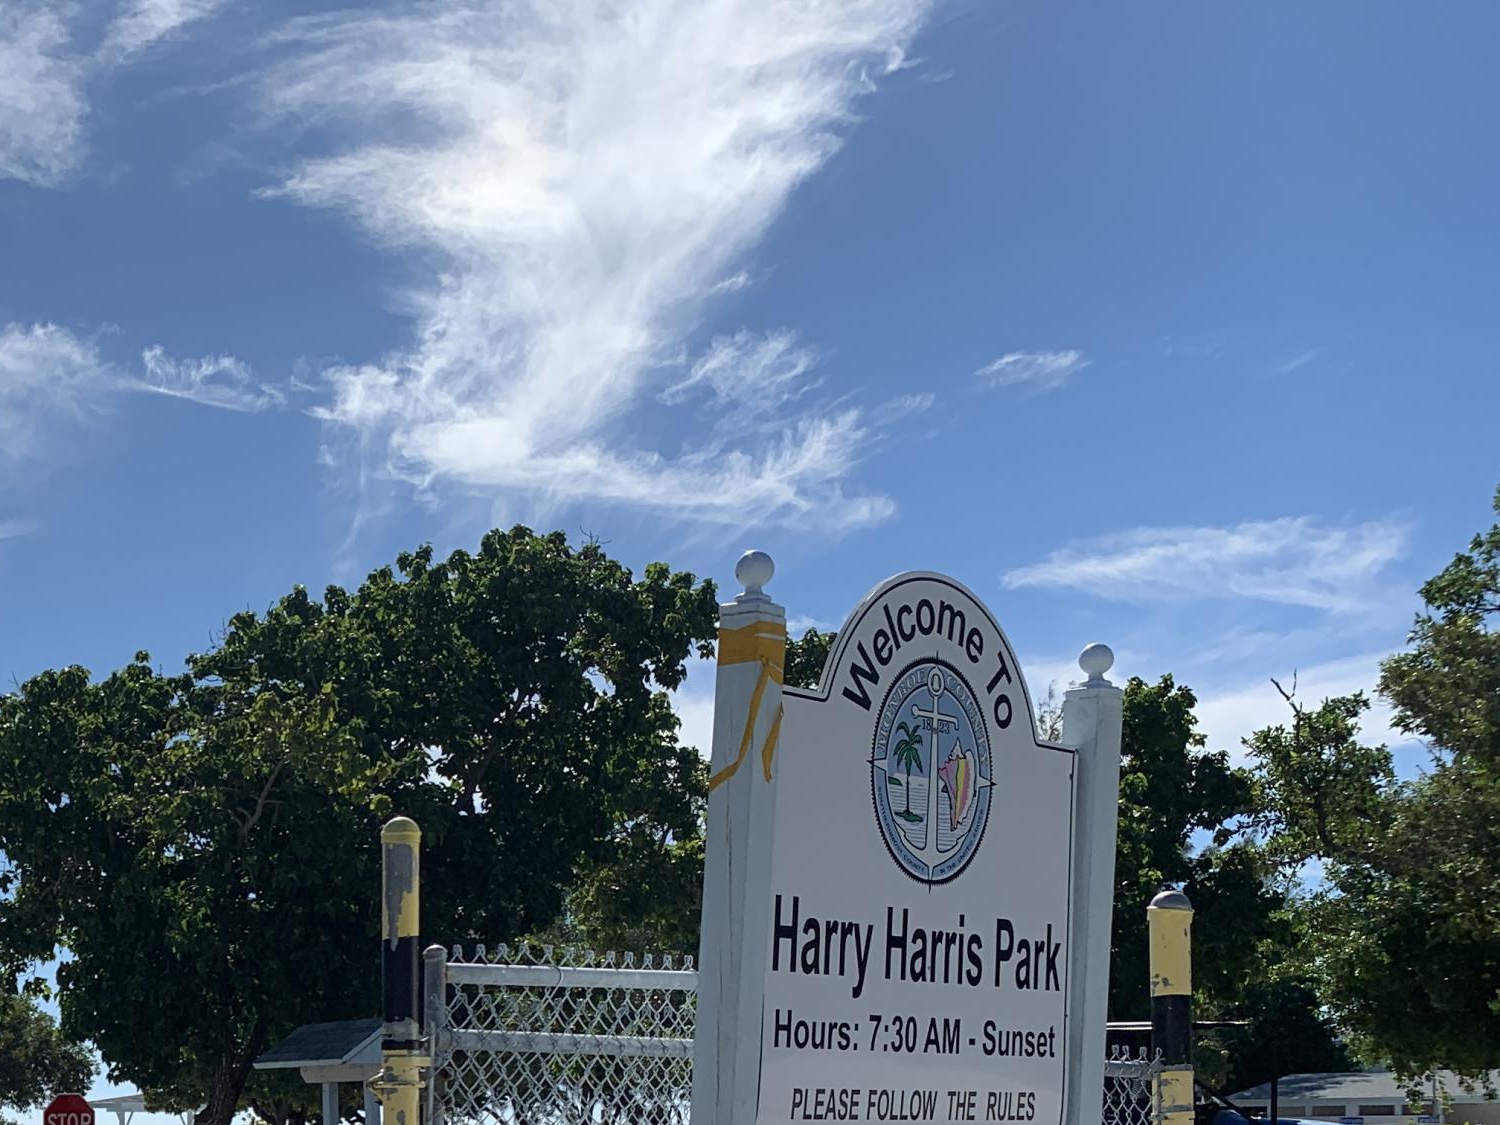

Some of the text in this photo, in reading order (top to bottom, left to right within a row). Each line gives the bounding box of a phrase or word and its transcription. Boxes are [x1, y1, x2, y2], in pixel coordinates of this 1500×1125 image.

[842, 599, 1013, 729] Welcome To
[772, 894, 1061, 999] Harry Harris Park
[773, 1009, 859, 1051] Hours:
[869, 1014, 918, 1053] 7:30
[923, 1017, 961, 1055] AM
[982, 1019, 1056, 1058] Sunset
[790, 1088, 1036, 1121] PLEASE FOLLOW THE RULES
